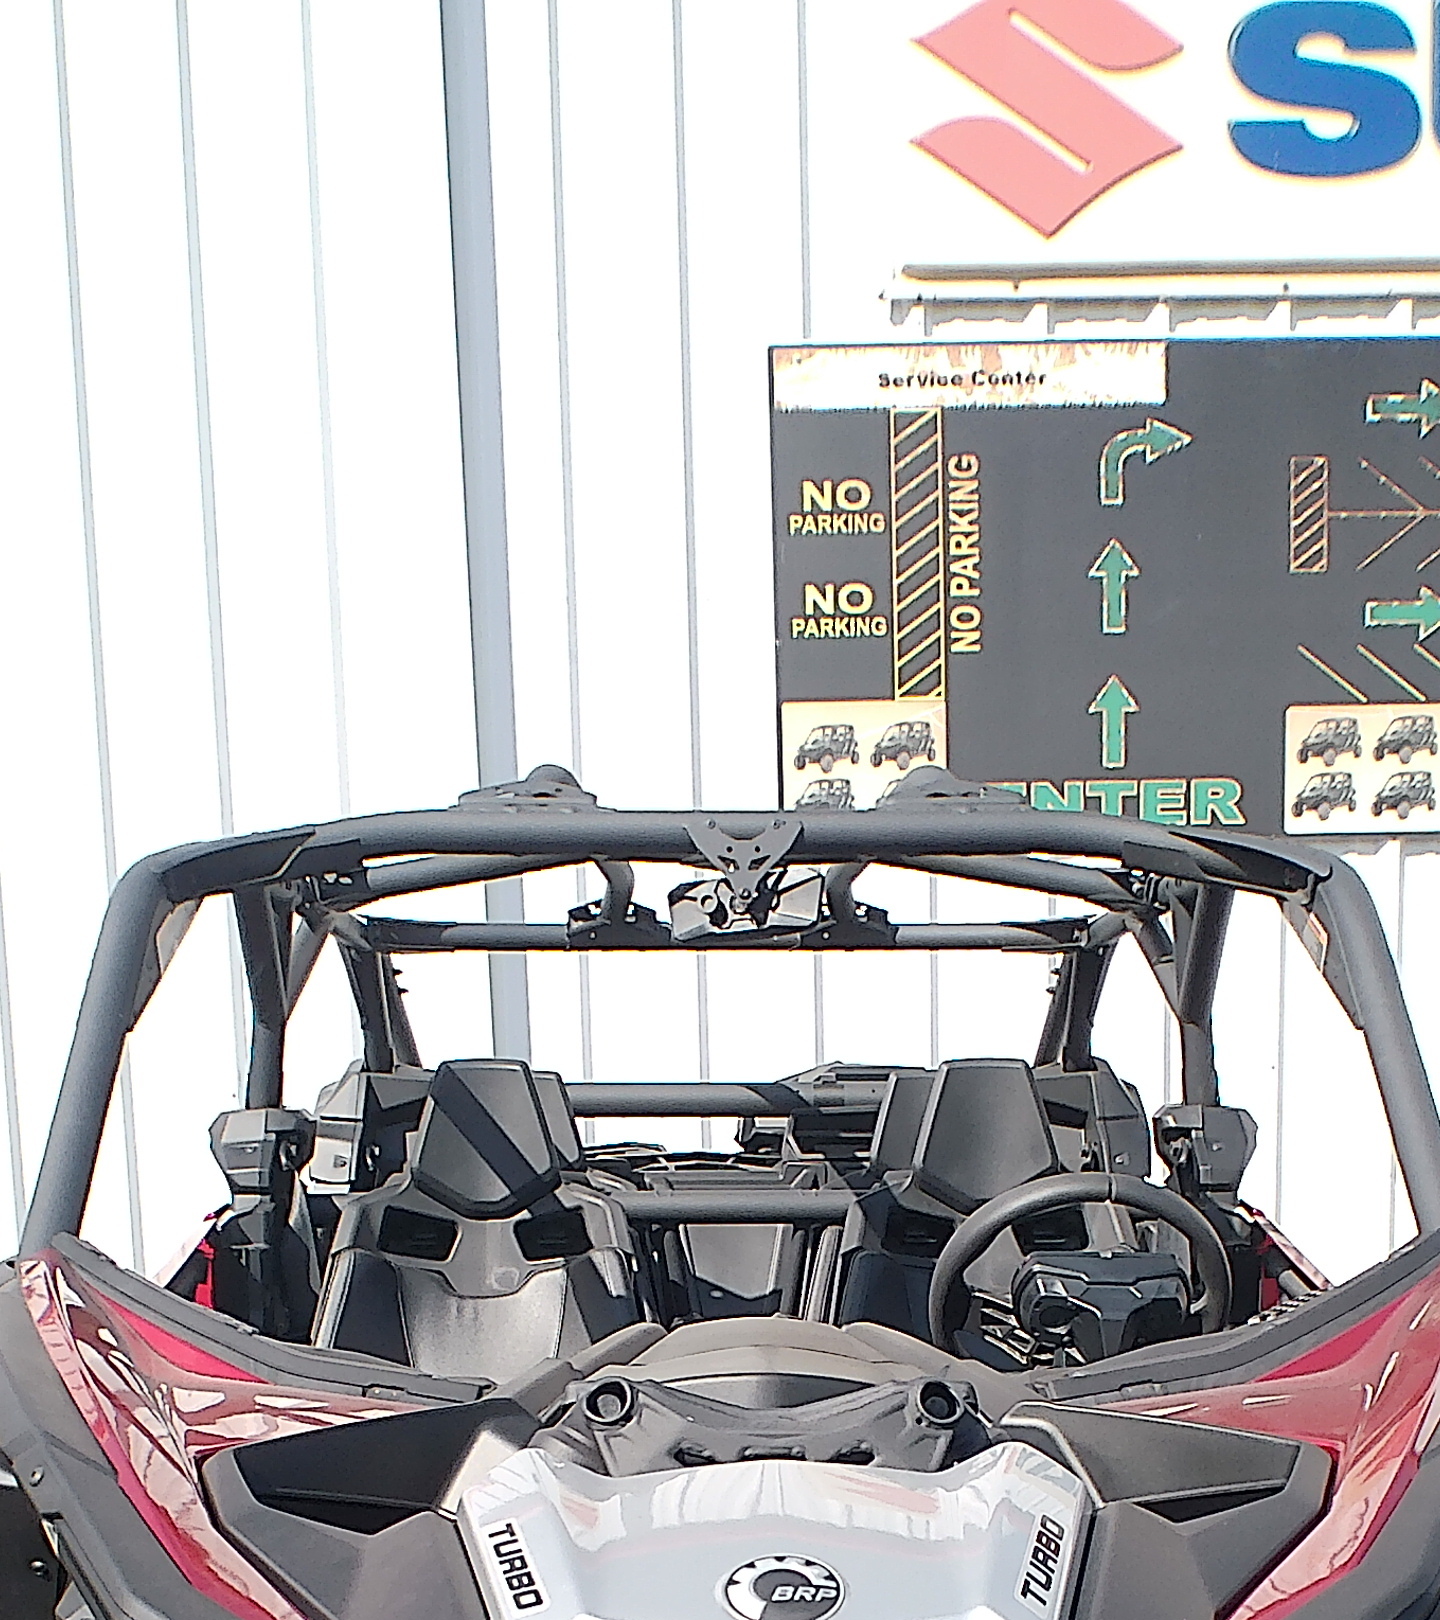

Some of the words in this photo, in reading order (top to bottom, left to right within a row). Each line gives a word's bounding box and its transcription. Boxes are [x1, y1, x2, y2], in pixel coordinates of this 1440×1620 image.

[801, 478, 872, 512] NO
[788, 511, 886, 536] PARKING
[948, 453, 981, 600] PARKING
[804, 582, 874, 616] NO
[791, 615, 888, 639] PARKING
[949, 603, 983, 654] NO
[984, 777, 1247, 826] NTER
[487, 1521, 544, 1611] TURBO
[1020, 1515, 1065, 1608] TURBO
[771, 1585, 838, 1603] BRP
